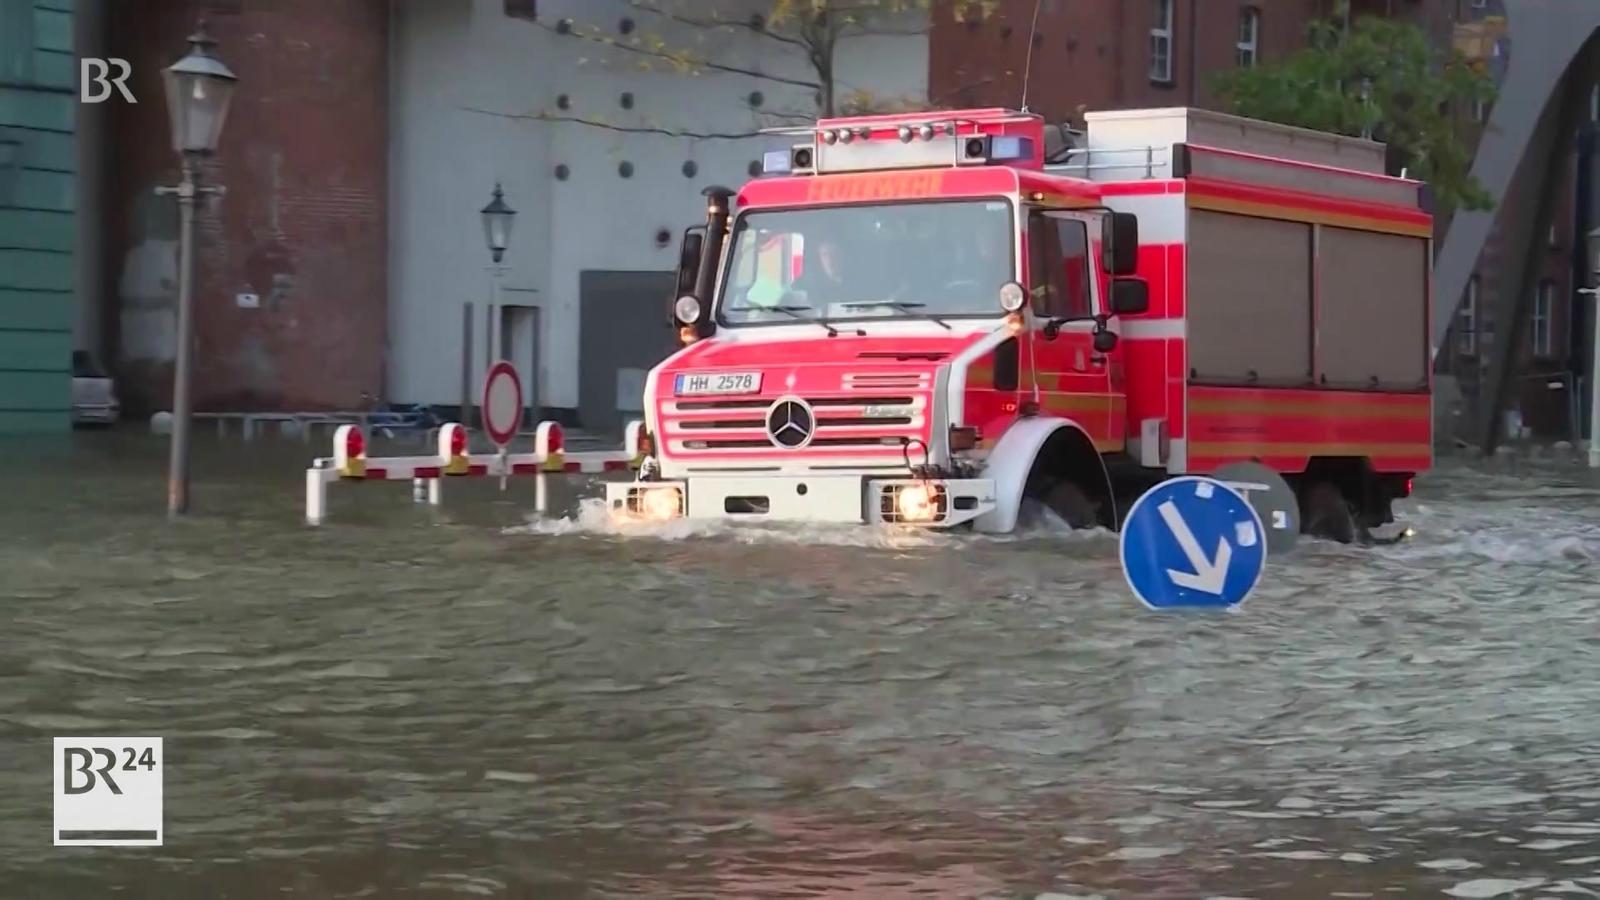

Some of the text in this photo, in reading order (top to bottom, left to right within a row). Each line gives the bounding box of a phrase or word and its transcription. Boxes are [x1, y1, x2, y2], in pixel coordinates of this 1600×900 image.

[807, 171, 943, 201] FEUERWEHR
[689, 374, 752, 391] HH 2578
